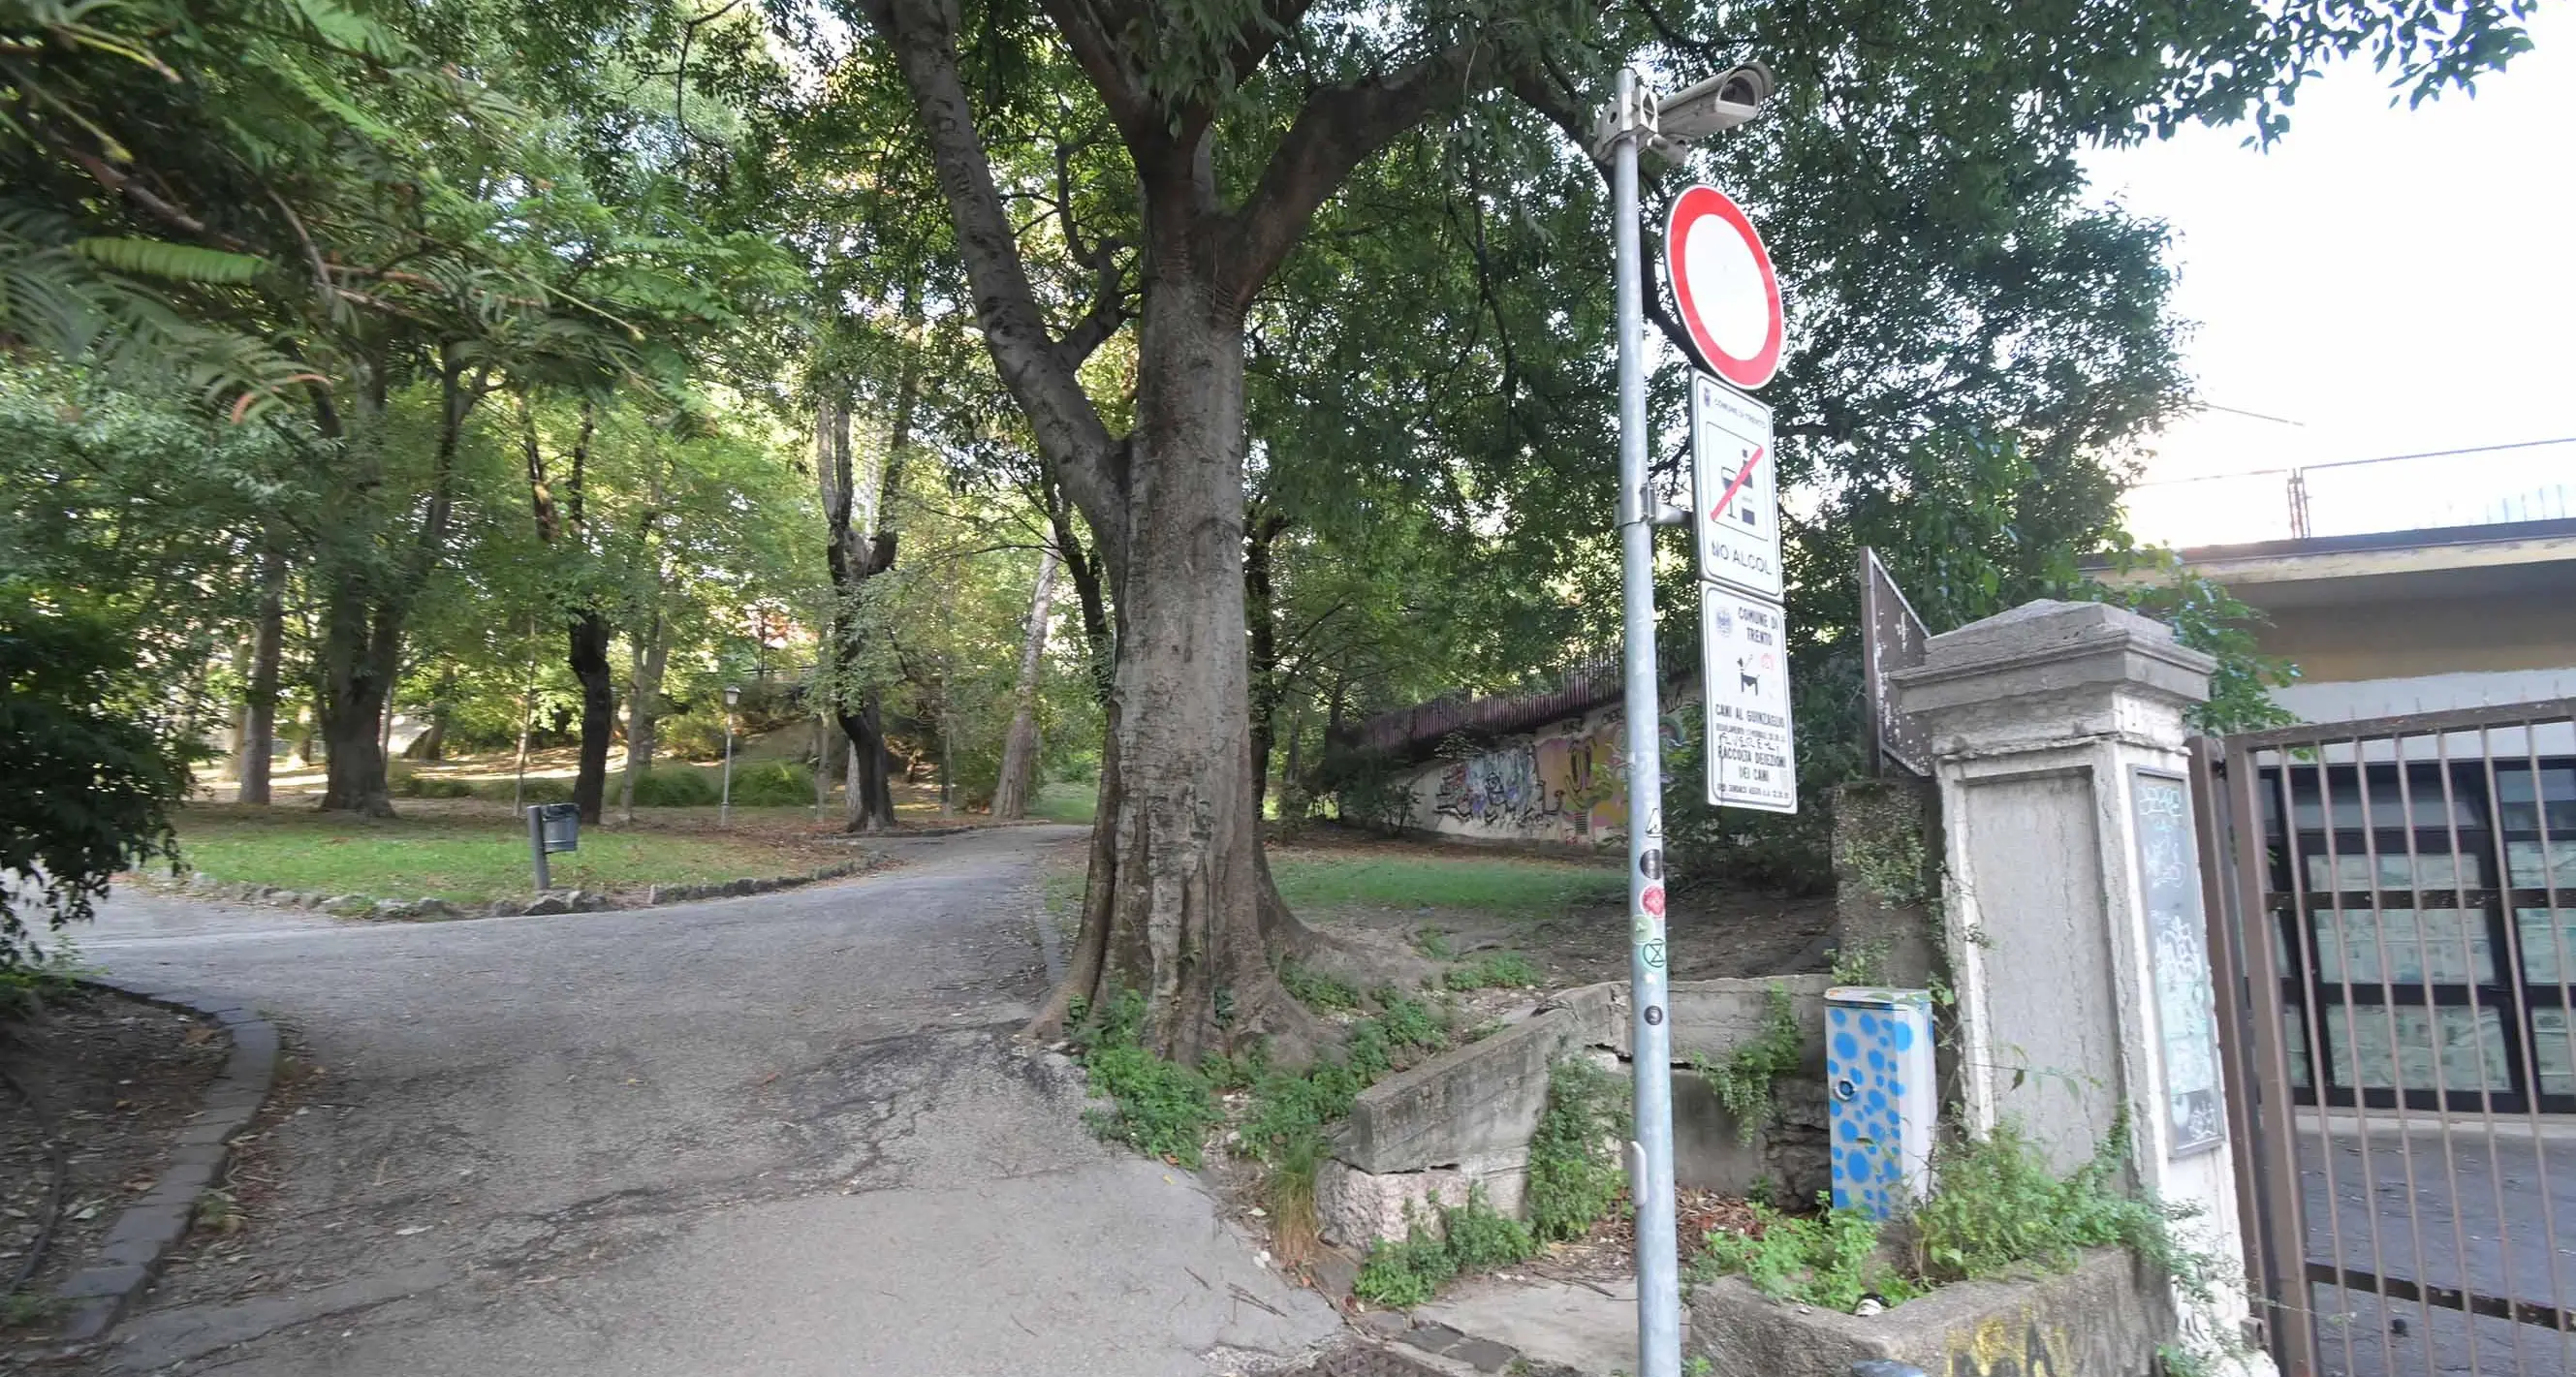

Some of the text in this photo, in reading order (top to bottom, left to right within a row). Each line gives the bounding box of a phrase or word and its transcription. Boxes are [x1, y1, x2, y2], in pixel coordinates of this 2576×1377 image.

[1712, 540, 1772, 575] NO ALCOL
[1739, 607, 1778, 630] COMUNE DI
[1746, 626, 1773, 645] TRENTO
[1715, 704, 1732, 717] CANI
[1736, 706, 1744, 720] AL
[1718, 745, 1751, 762] RACCOLTA
